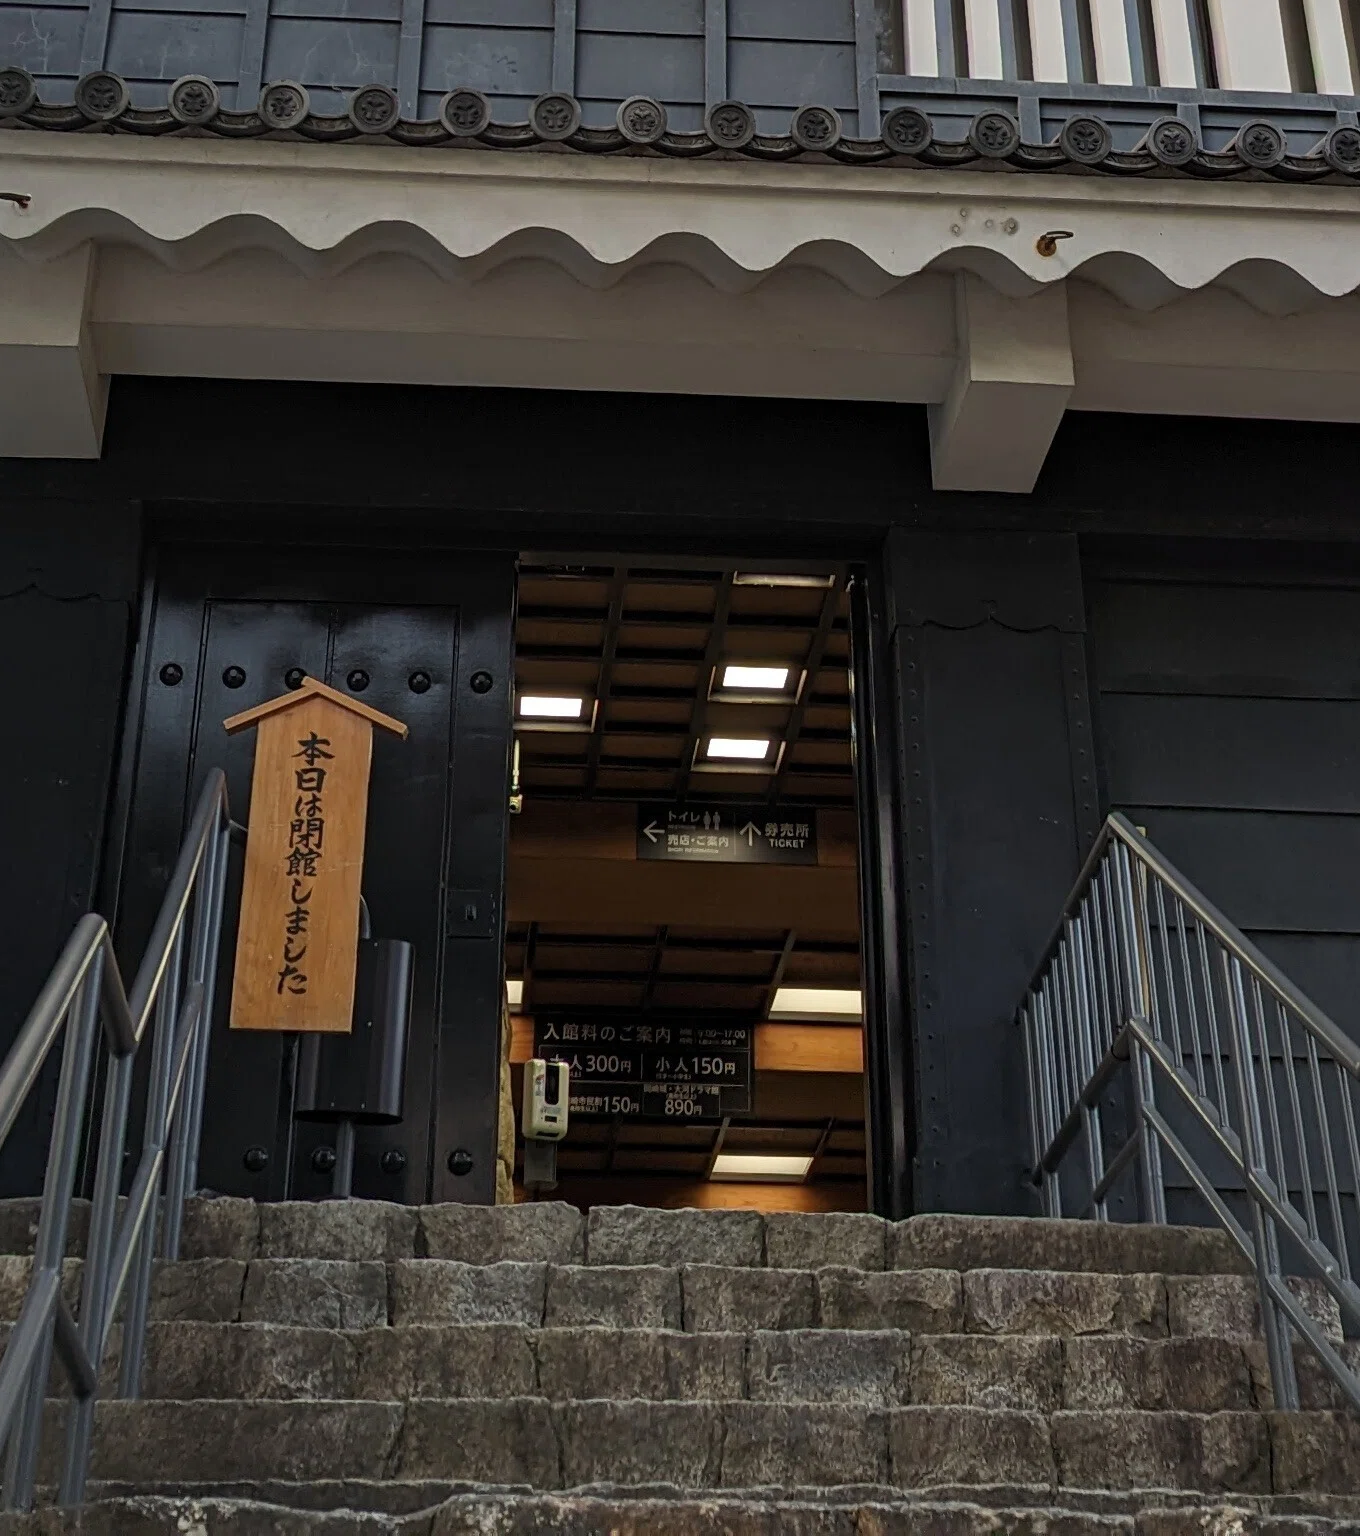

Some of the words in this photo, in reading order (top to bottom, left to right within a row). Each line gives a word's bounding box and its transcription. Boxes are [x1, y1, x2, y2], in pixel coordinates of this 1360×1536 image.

[668, 810, 700, 823] トイレ
[764, 822, 809, 838] 券売所
[768, 838, 805, 849] TICKET
[277, 731, 335, 995] 本日は閉館しました
[543, 1021, 672, 1045] 入館料のご案内
[665, 1099, 702, 1116] 890円
